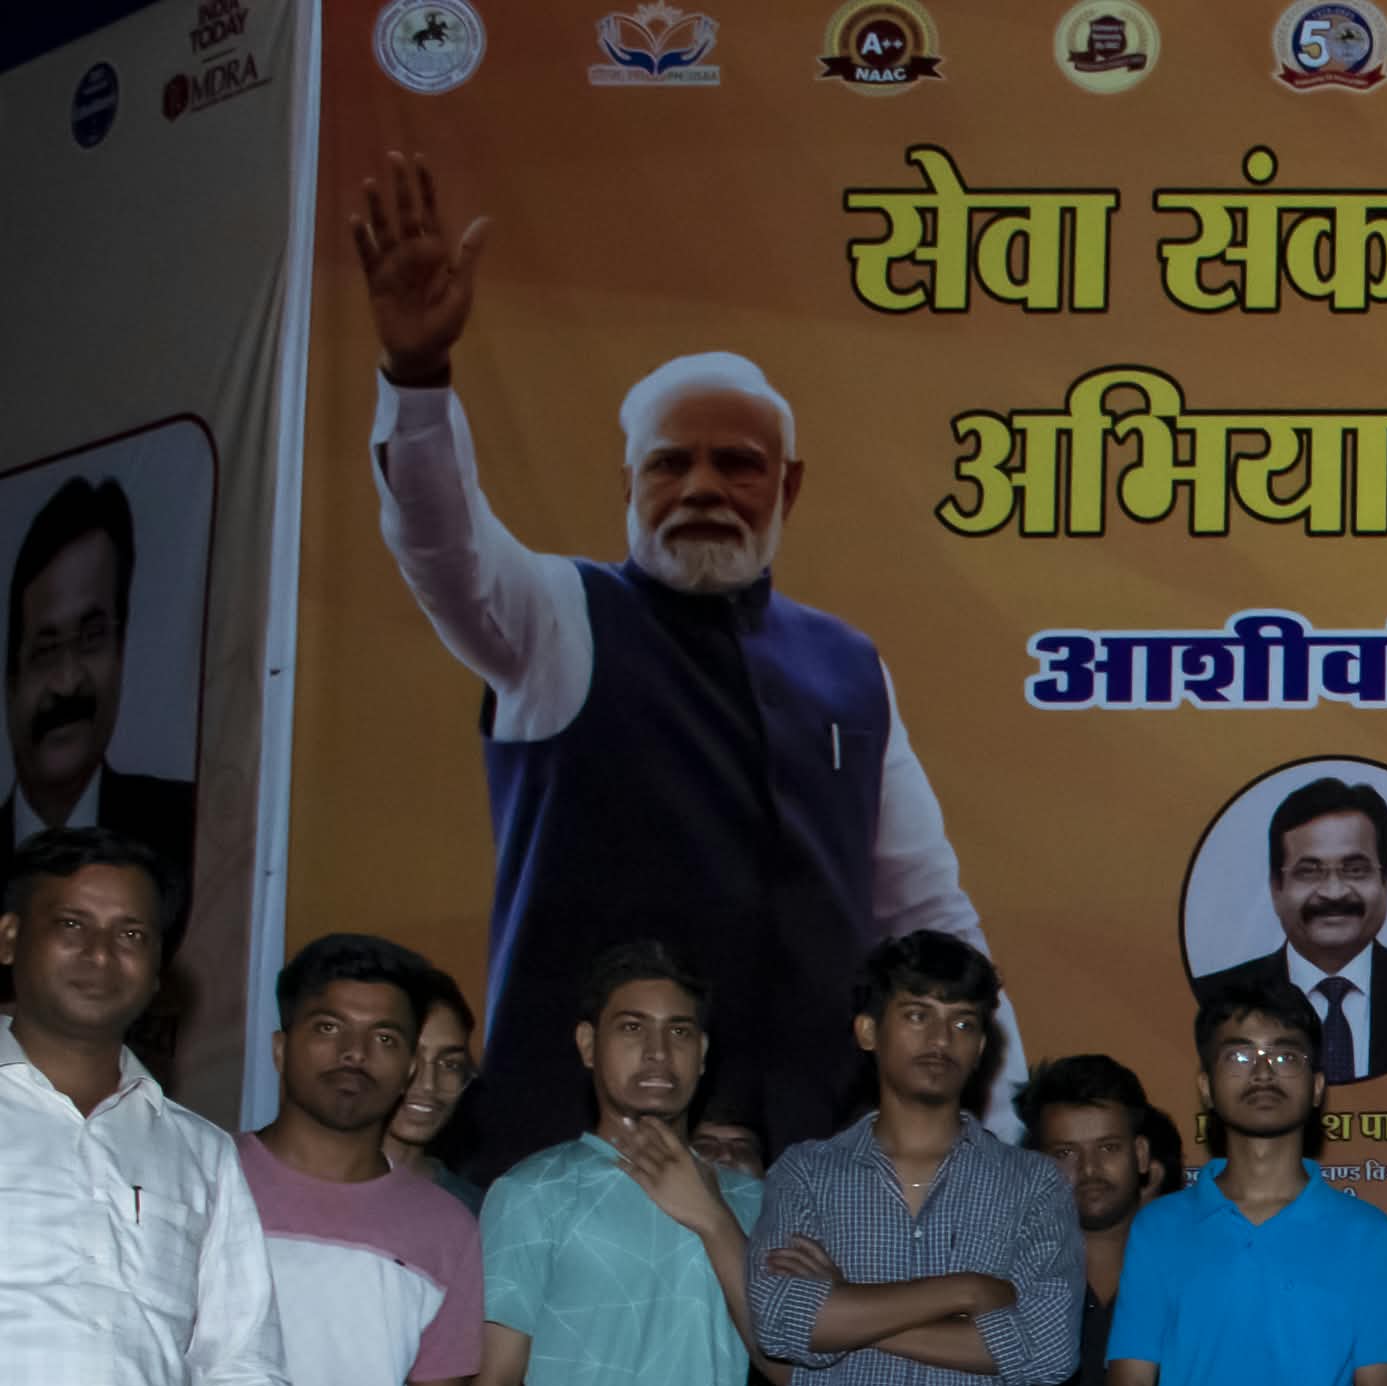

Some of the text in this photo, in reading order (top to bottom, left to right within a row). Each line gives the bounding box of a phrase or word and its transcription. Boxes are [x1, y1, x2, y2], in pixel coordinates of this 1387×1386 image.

[190, 8, 249, 53] TODAY
[861, 32, 903, 55] A++
[192, 53, 258, 105] MDRA
[855, 67, 907, 82] NAAC
[843, 144, 1119, 312] सेवा
